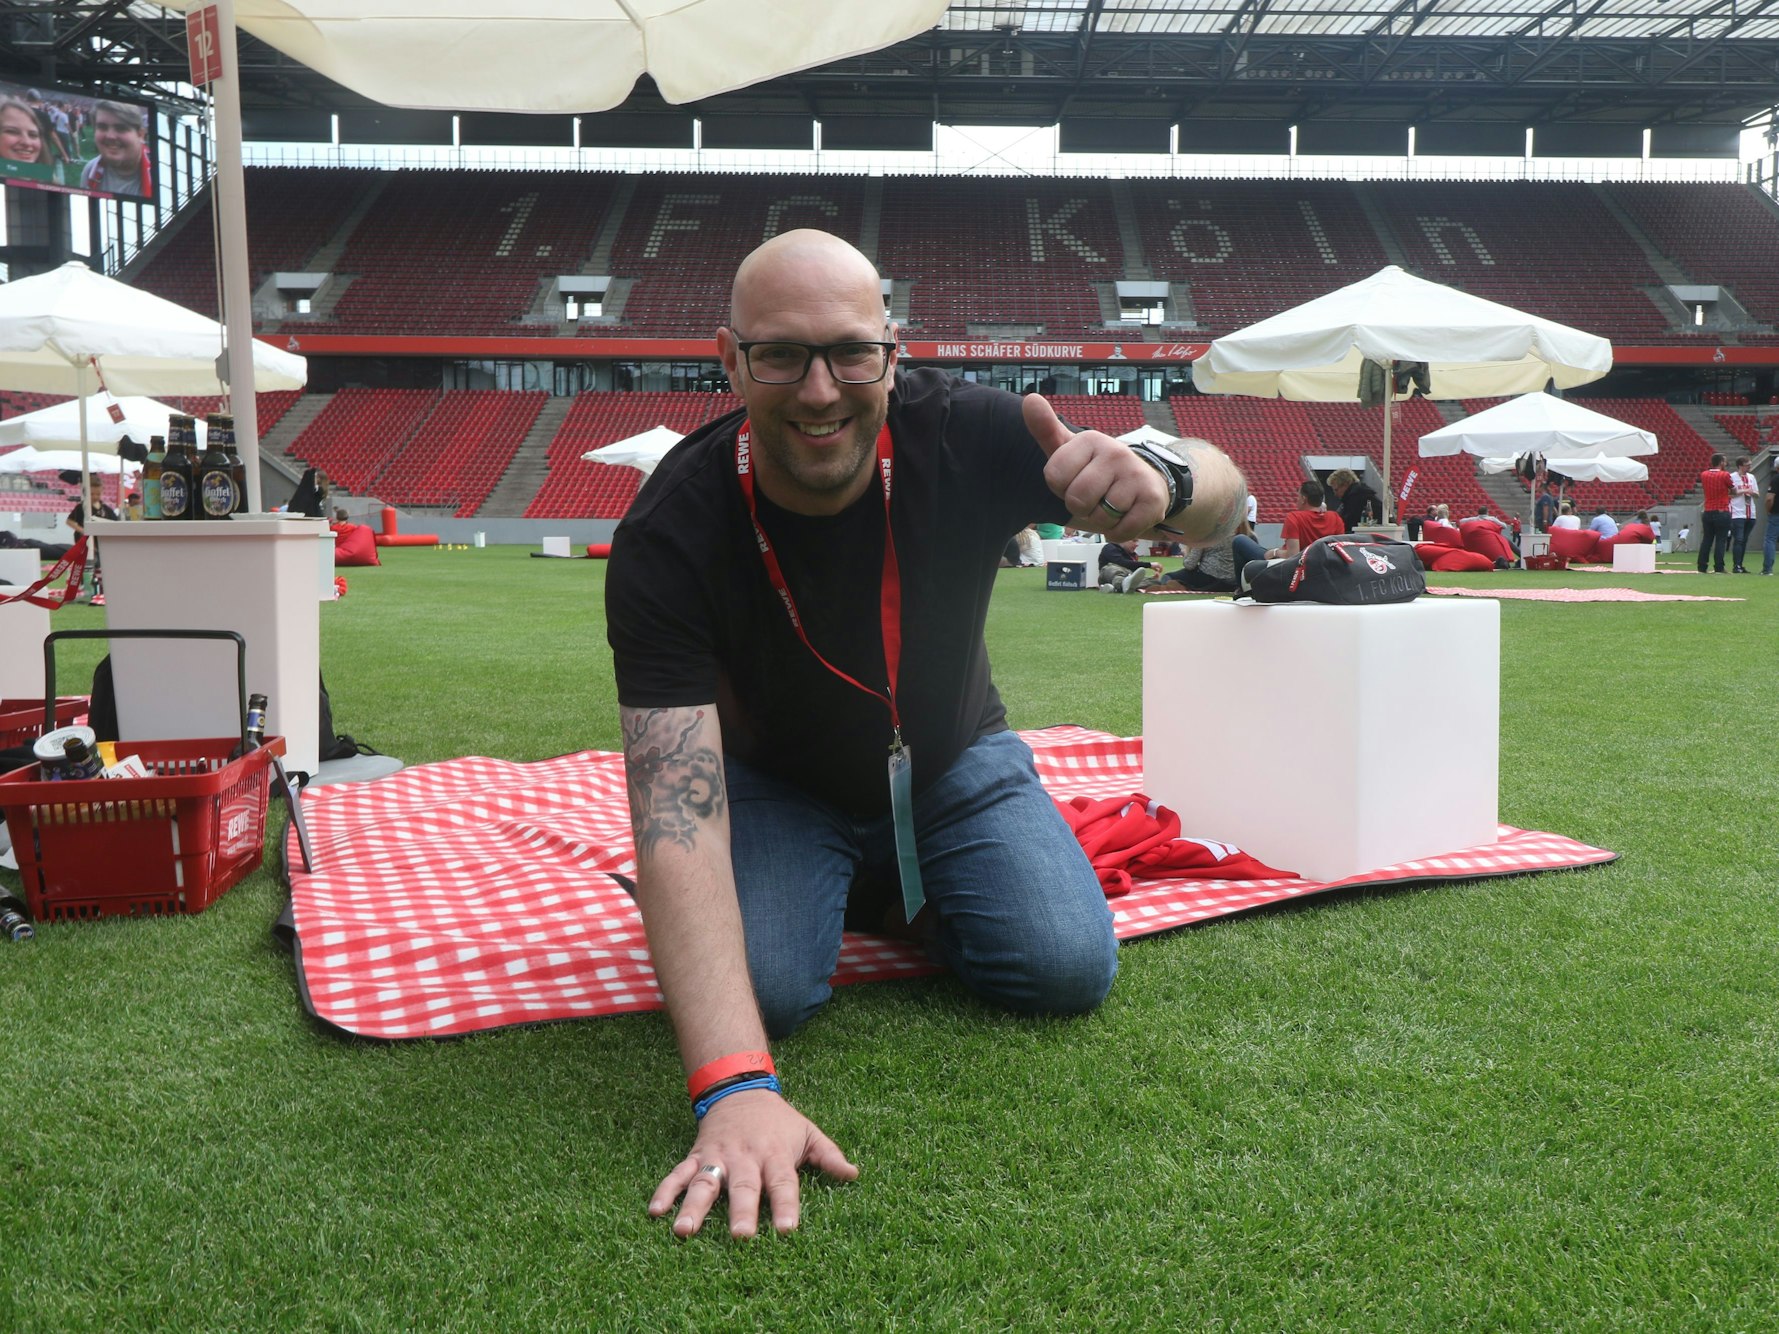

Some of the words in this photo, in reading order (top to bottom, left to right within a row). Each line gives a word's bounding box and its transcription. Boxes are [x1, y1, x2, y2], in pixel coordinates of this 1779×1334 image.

[194, 30, 214, 59] 12
[495, 191, 552, 256] 1.
[1025, 198, 1496, 266] Köln
[937, 344, 966, 357] HANS
[970, 342, 1021, 358] SCHÄFER
[1024, 343, 1083, 358] SÜDKURVE
[737, 432, 749, 474] REWE
[1400, 470, 1418, 500] REWE
[70, 564, 82, 586] REWE
[1370, 579, 1387, 599] FC
[778, 587, 799, 628] REWE
[228, 809, 250, 842] REWE
